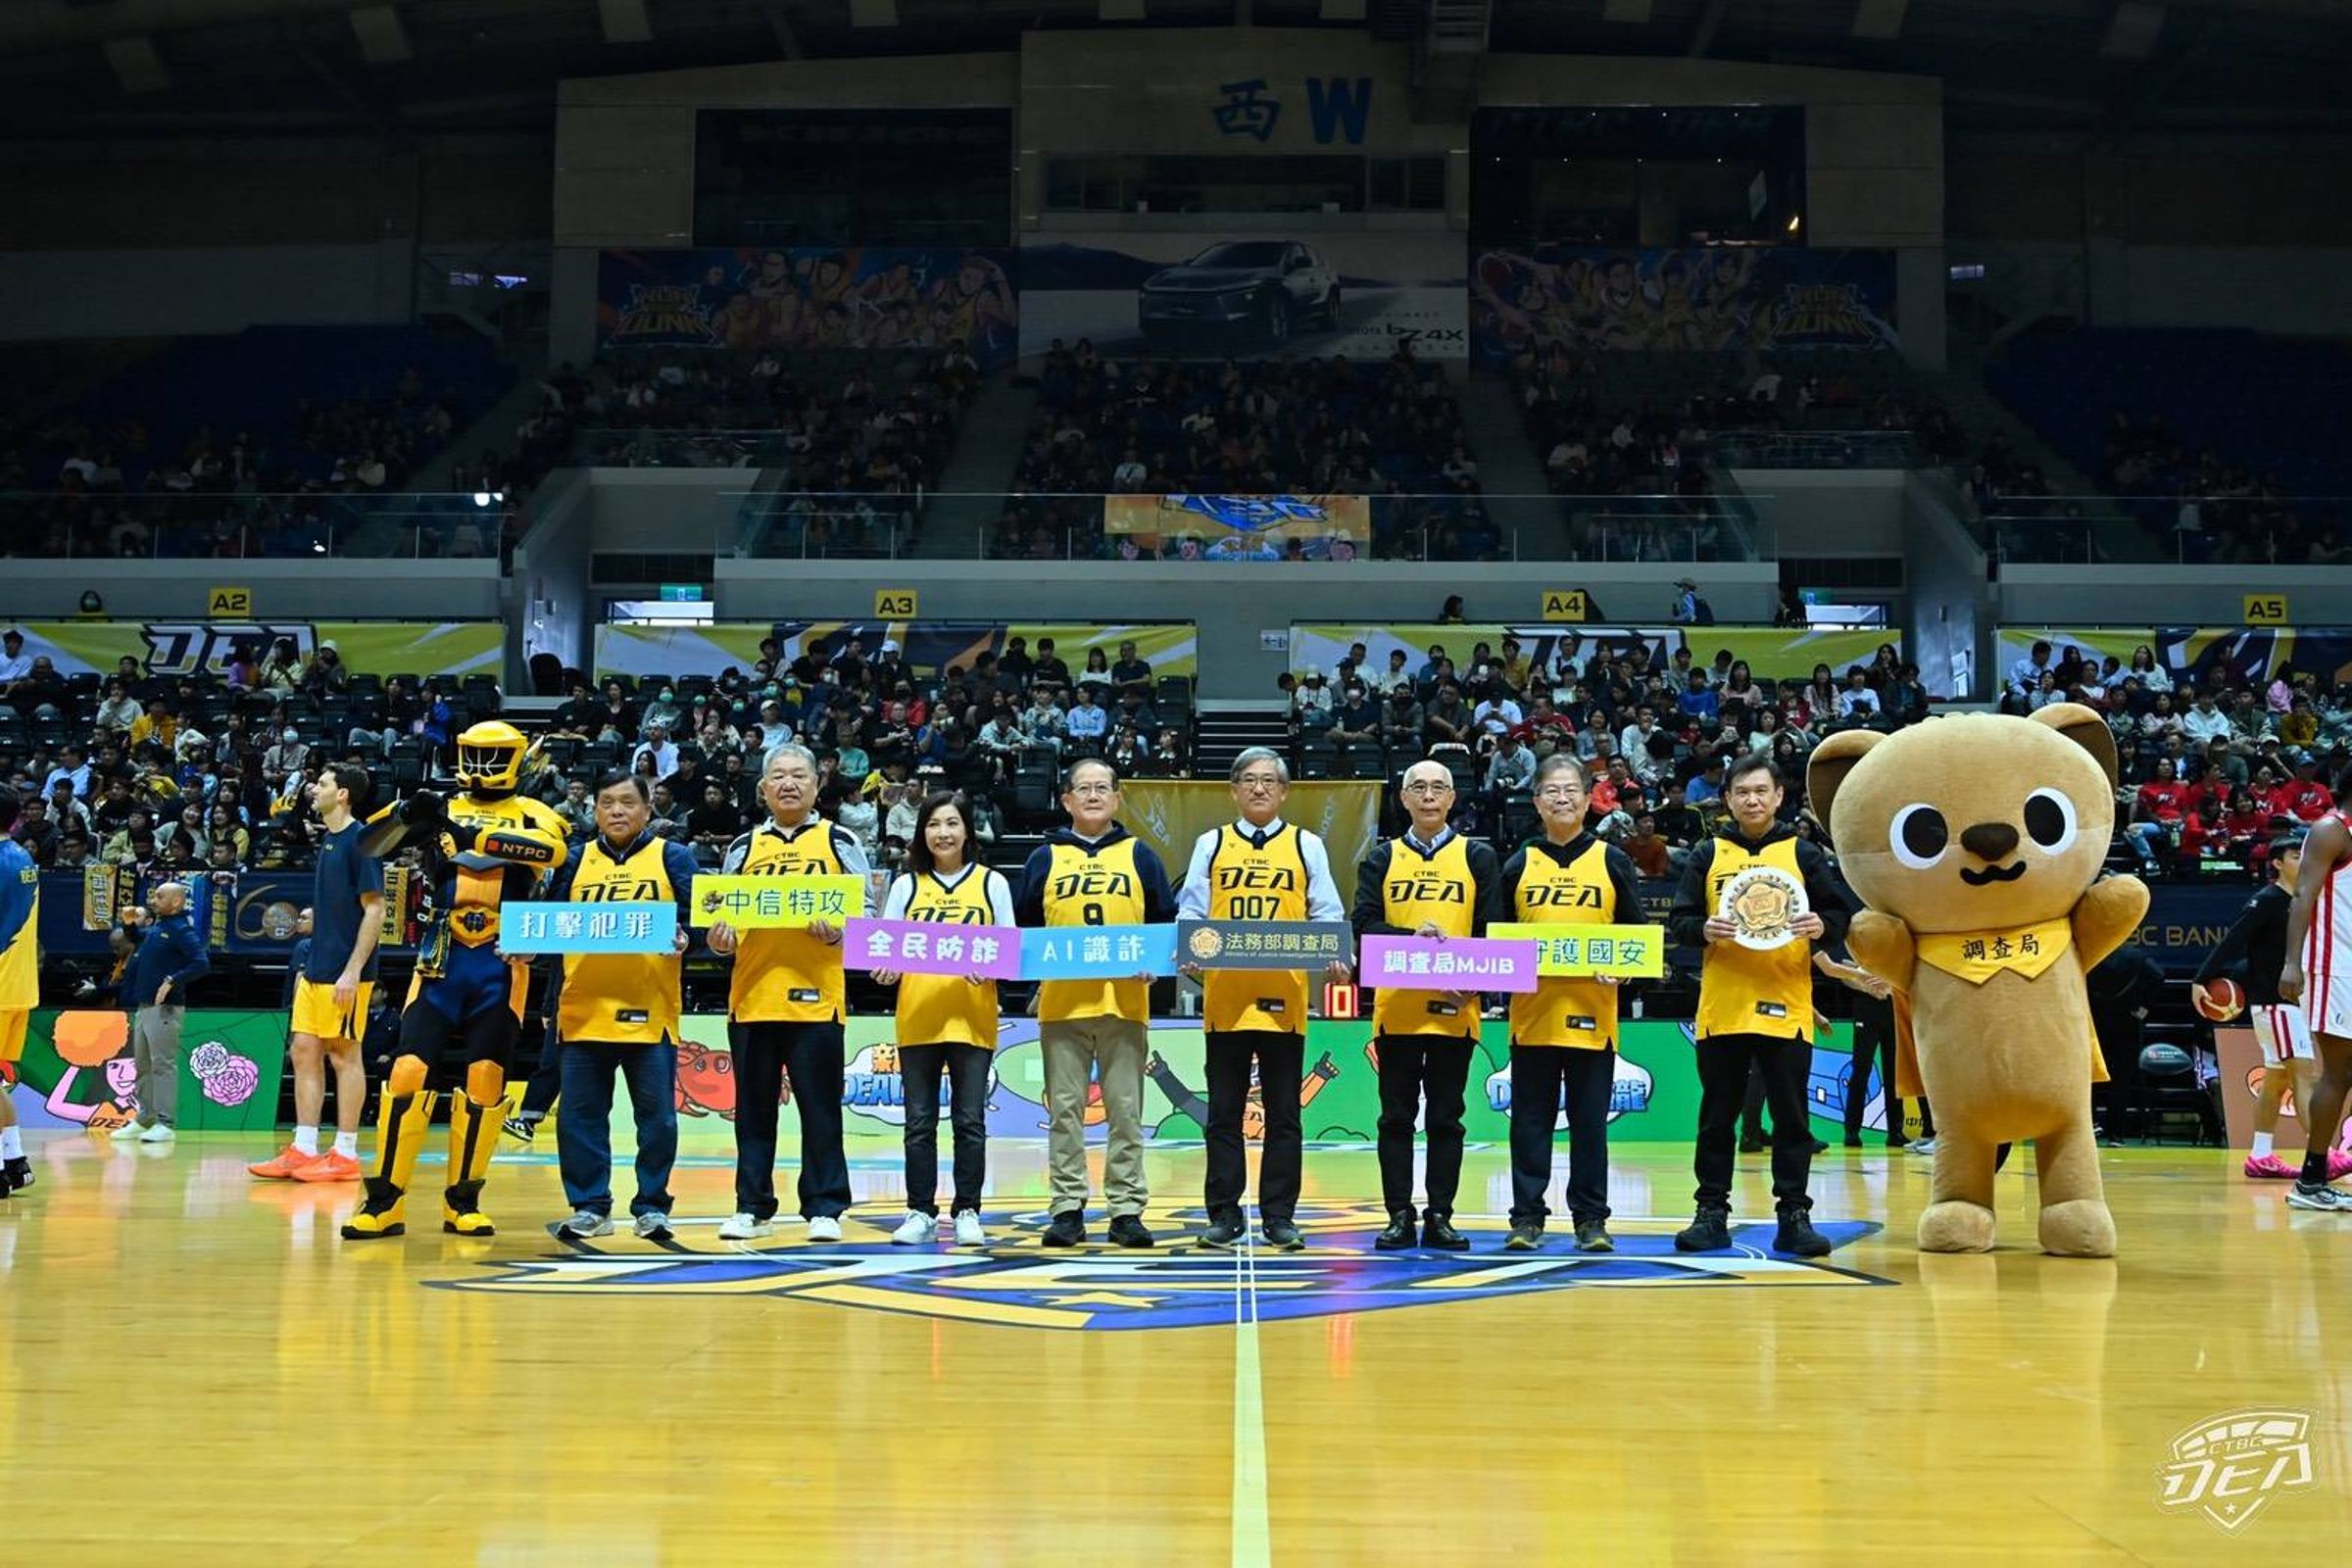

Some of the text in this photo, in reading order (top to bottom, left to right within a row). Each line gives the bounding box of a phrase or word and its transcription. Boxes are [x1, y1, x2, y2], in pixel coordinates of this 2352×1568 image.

[1213, 78, 1282, 142] 西
[1306, 77, 1372, 144] W
[212, 594, 247, 612] A2
[879, 597, 912, 614] A3
[1545, 597, 1582, 613] A4
[2248, 601, 2282, 618] A5
[502, 843, 548, 859] NTPC
[1054, 872, 1132, 900] DEA
[1220, 866, 1295, 891] DEA
[579, 880, 661, 902] DEA
[726, 889, 846, 915] 中信特攻
[1389, 879, 1465, 904] DEA
[1525, 885, 1602, 908] DEA
[1639, 897, 1672, 908] CTB
[1083, 903, 1104, 925] 9
[1230, 896, 1281, 919] 007
[520, 910, 653, 939] 打擊犯罪
[867, 930, 1000, 963] 全民防詐
[1226, 934, 1340, 952] 法務部調查局
[1961, 934, 2039, 960] 調查局
[1383, 951, 1515, 975] 調查局MJIB
